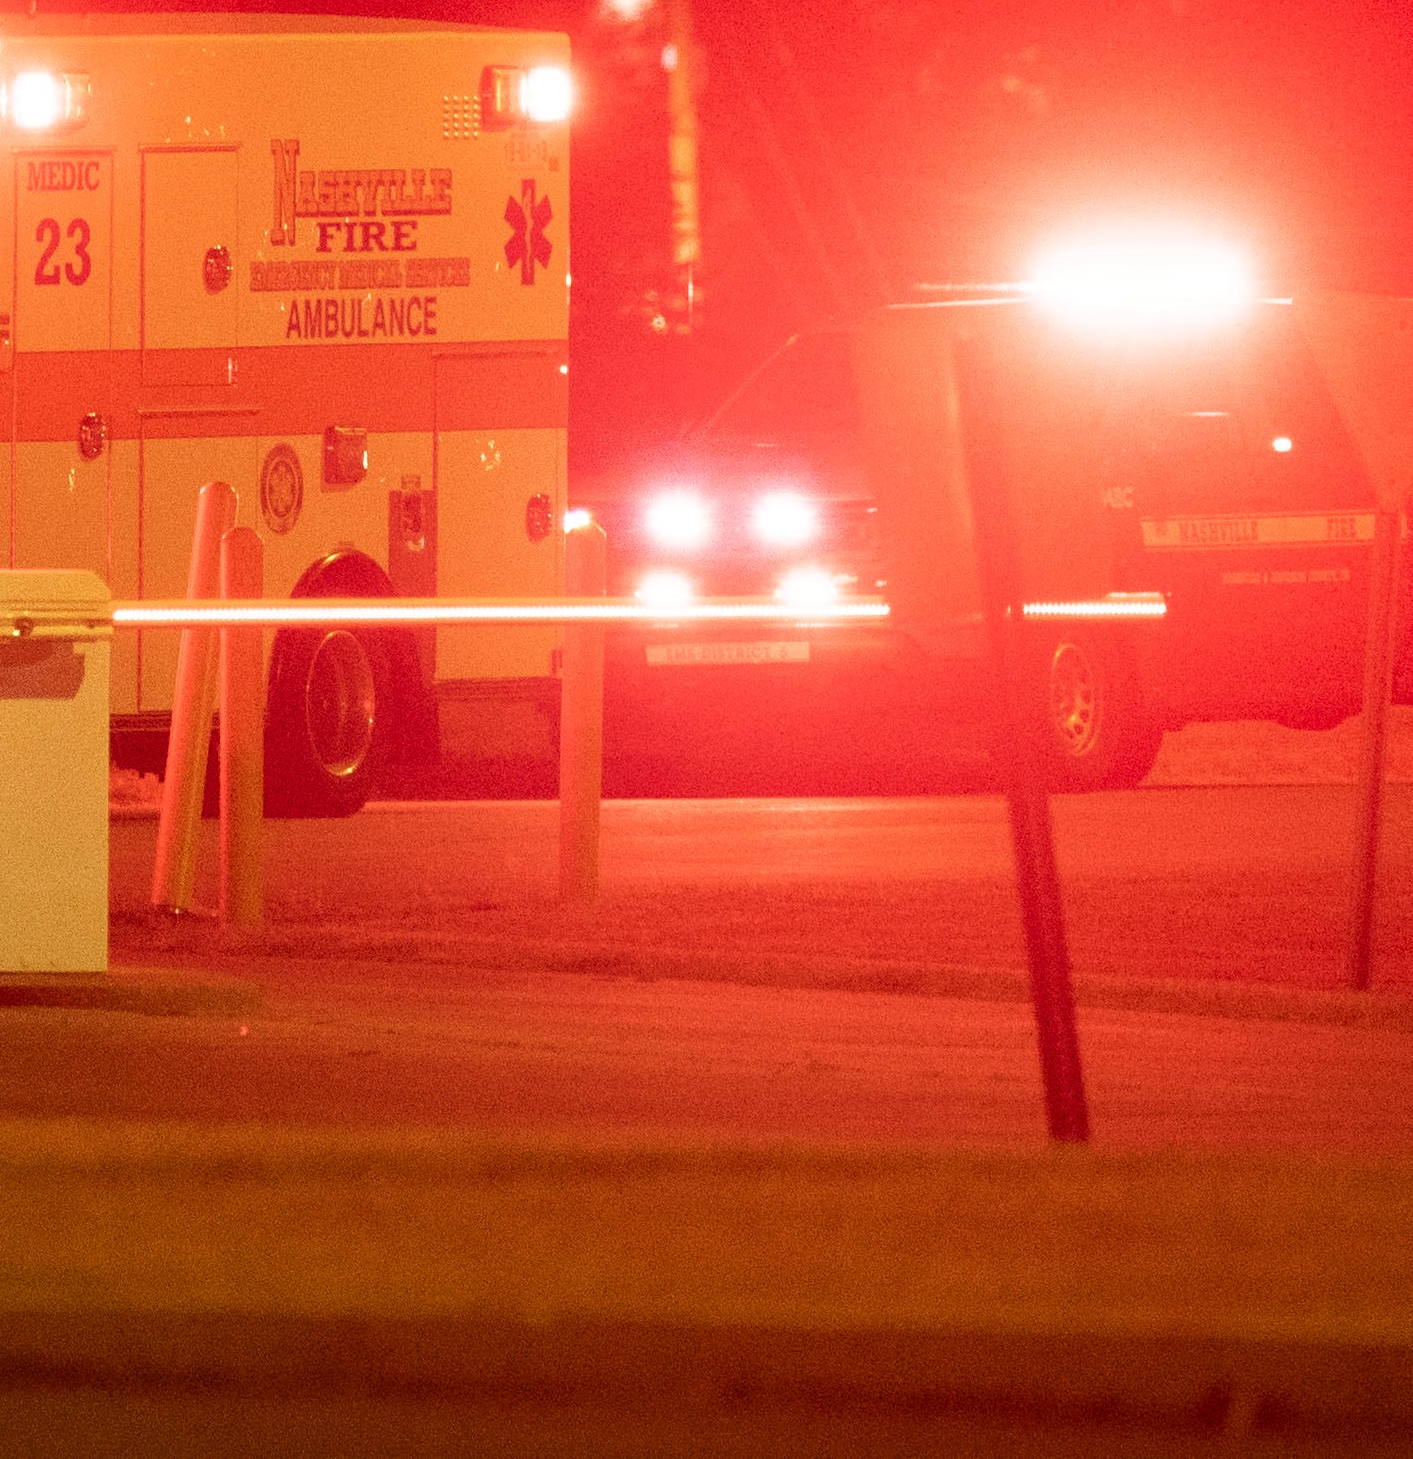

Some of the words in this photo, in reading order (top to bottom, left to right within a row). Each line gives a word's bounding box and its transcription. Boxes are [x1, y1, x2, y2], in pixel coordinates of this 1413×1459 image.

[27, 160, 100, 191] MEDIC
[271, 138, 452, 246] NASHVILLE
[34, 217, 91, 286] 23
[315, 220, 419, 253] FIRE
[286, 296, 438, 339] AMBULANCE
